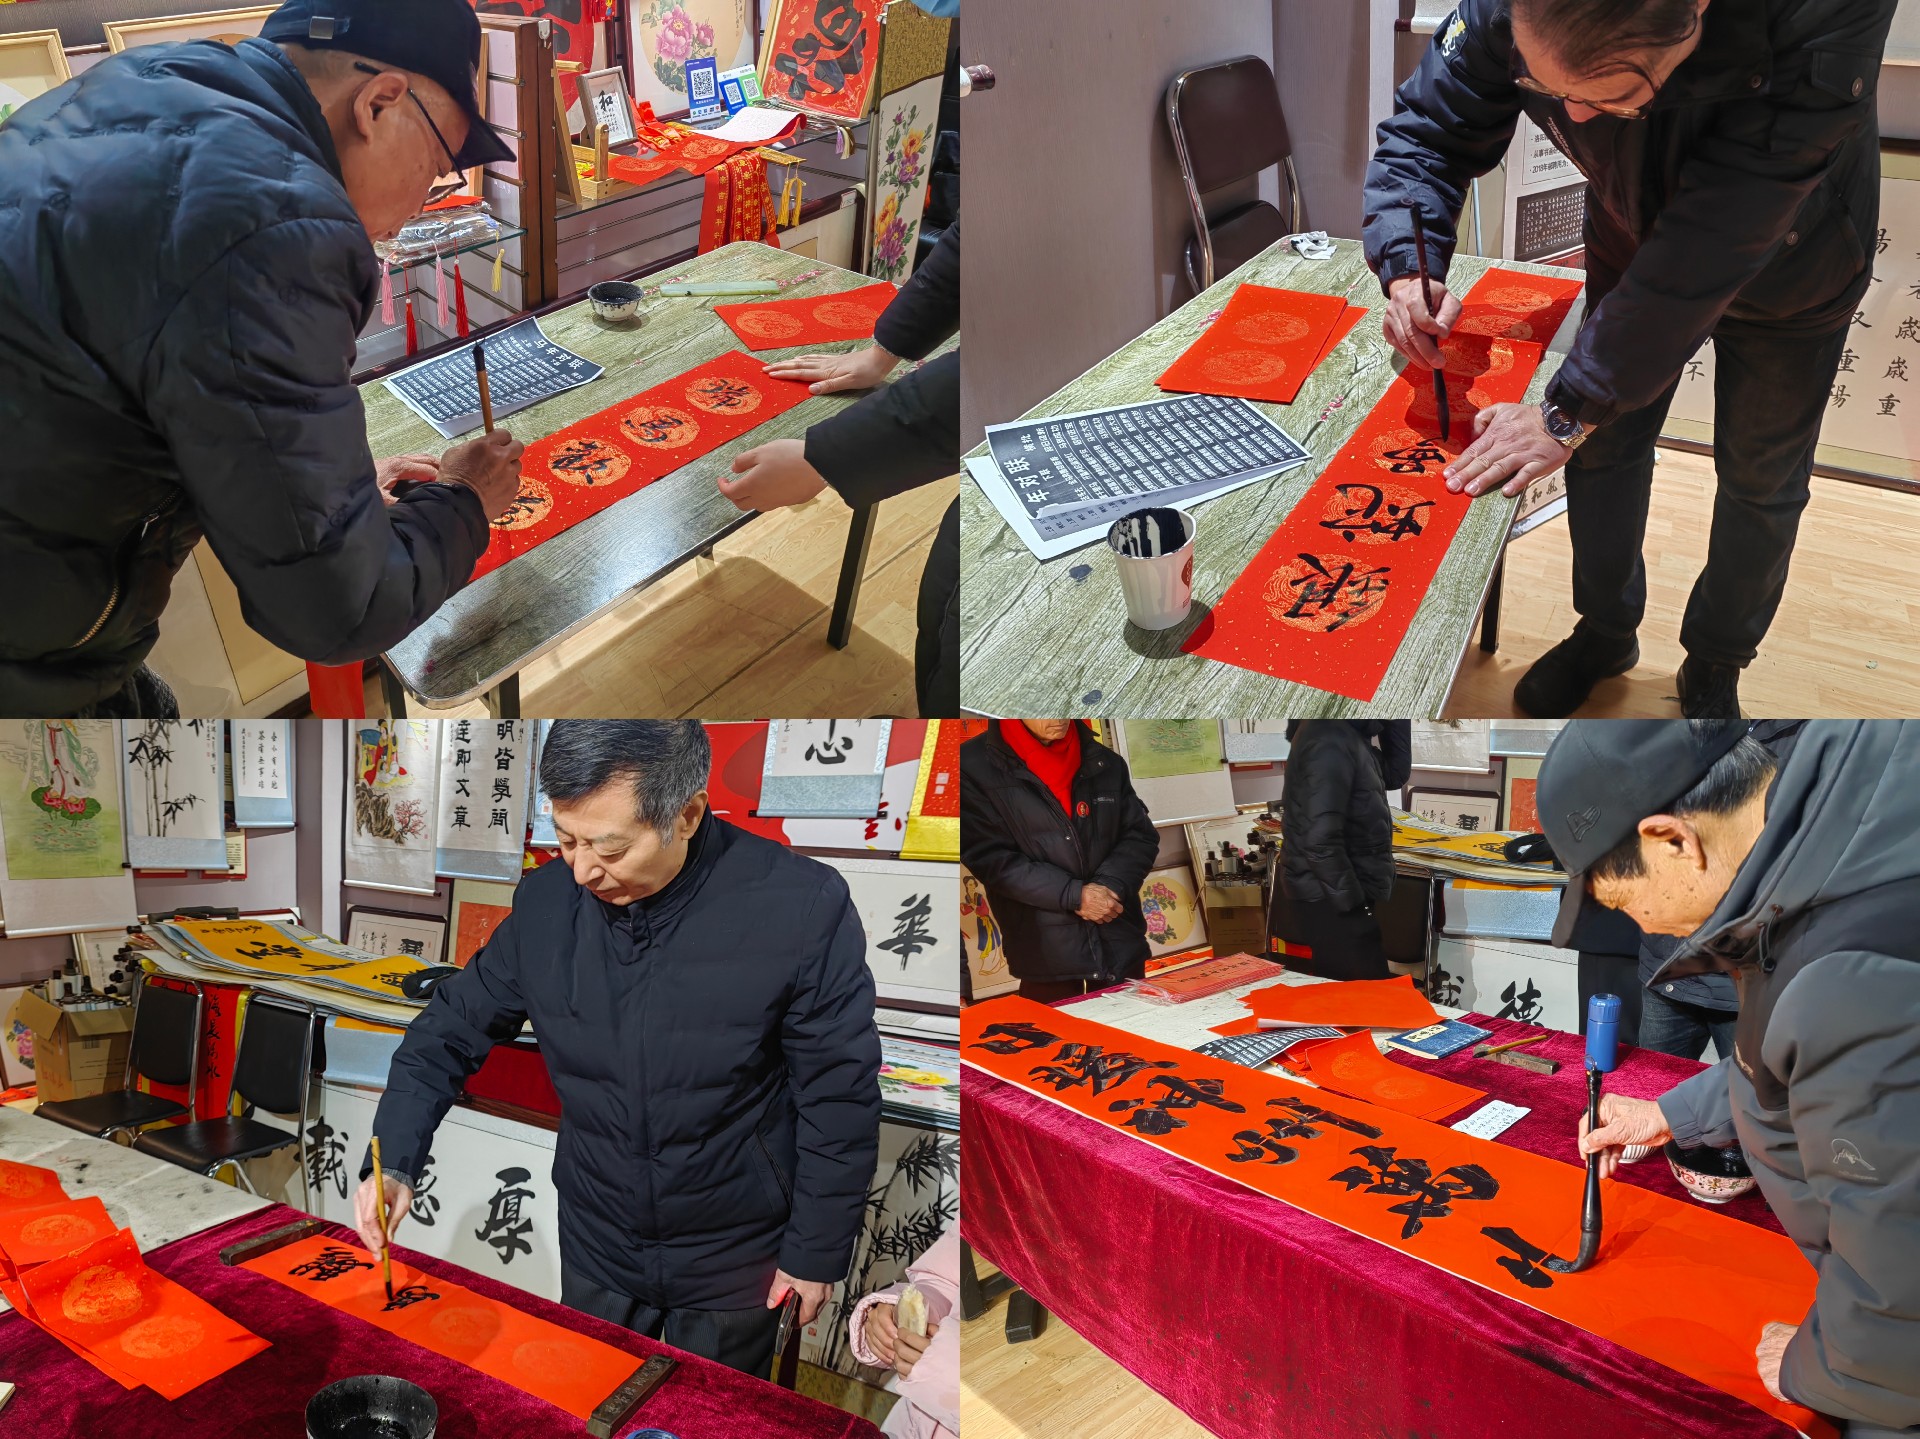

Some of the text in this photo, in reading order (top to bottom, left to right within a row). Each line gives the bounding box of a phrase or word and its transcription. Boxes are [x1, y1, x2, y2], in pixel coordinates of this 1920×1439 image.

[598, 90, 613, 112] 和
[530, 337, 587, 370] 马年对联
[876, 893, 938, 971] 華
